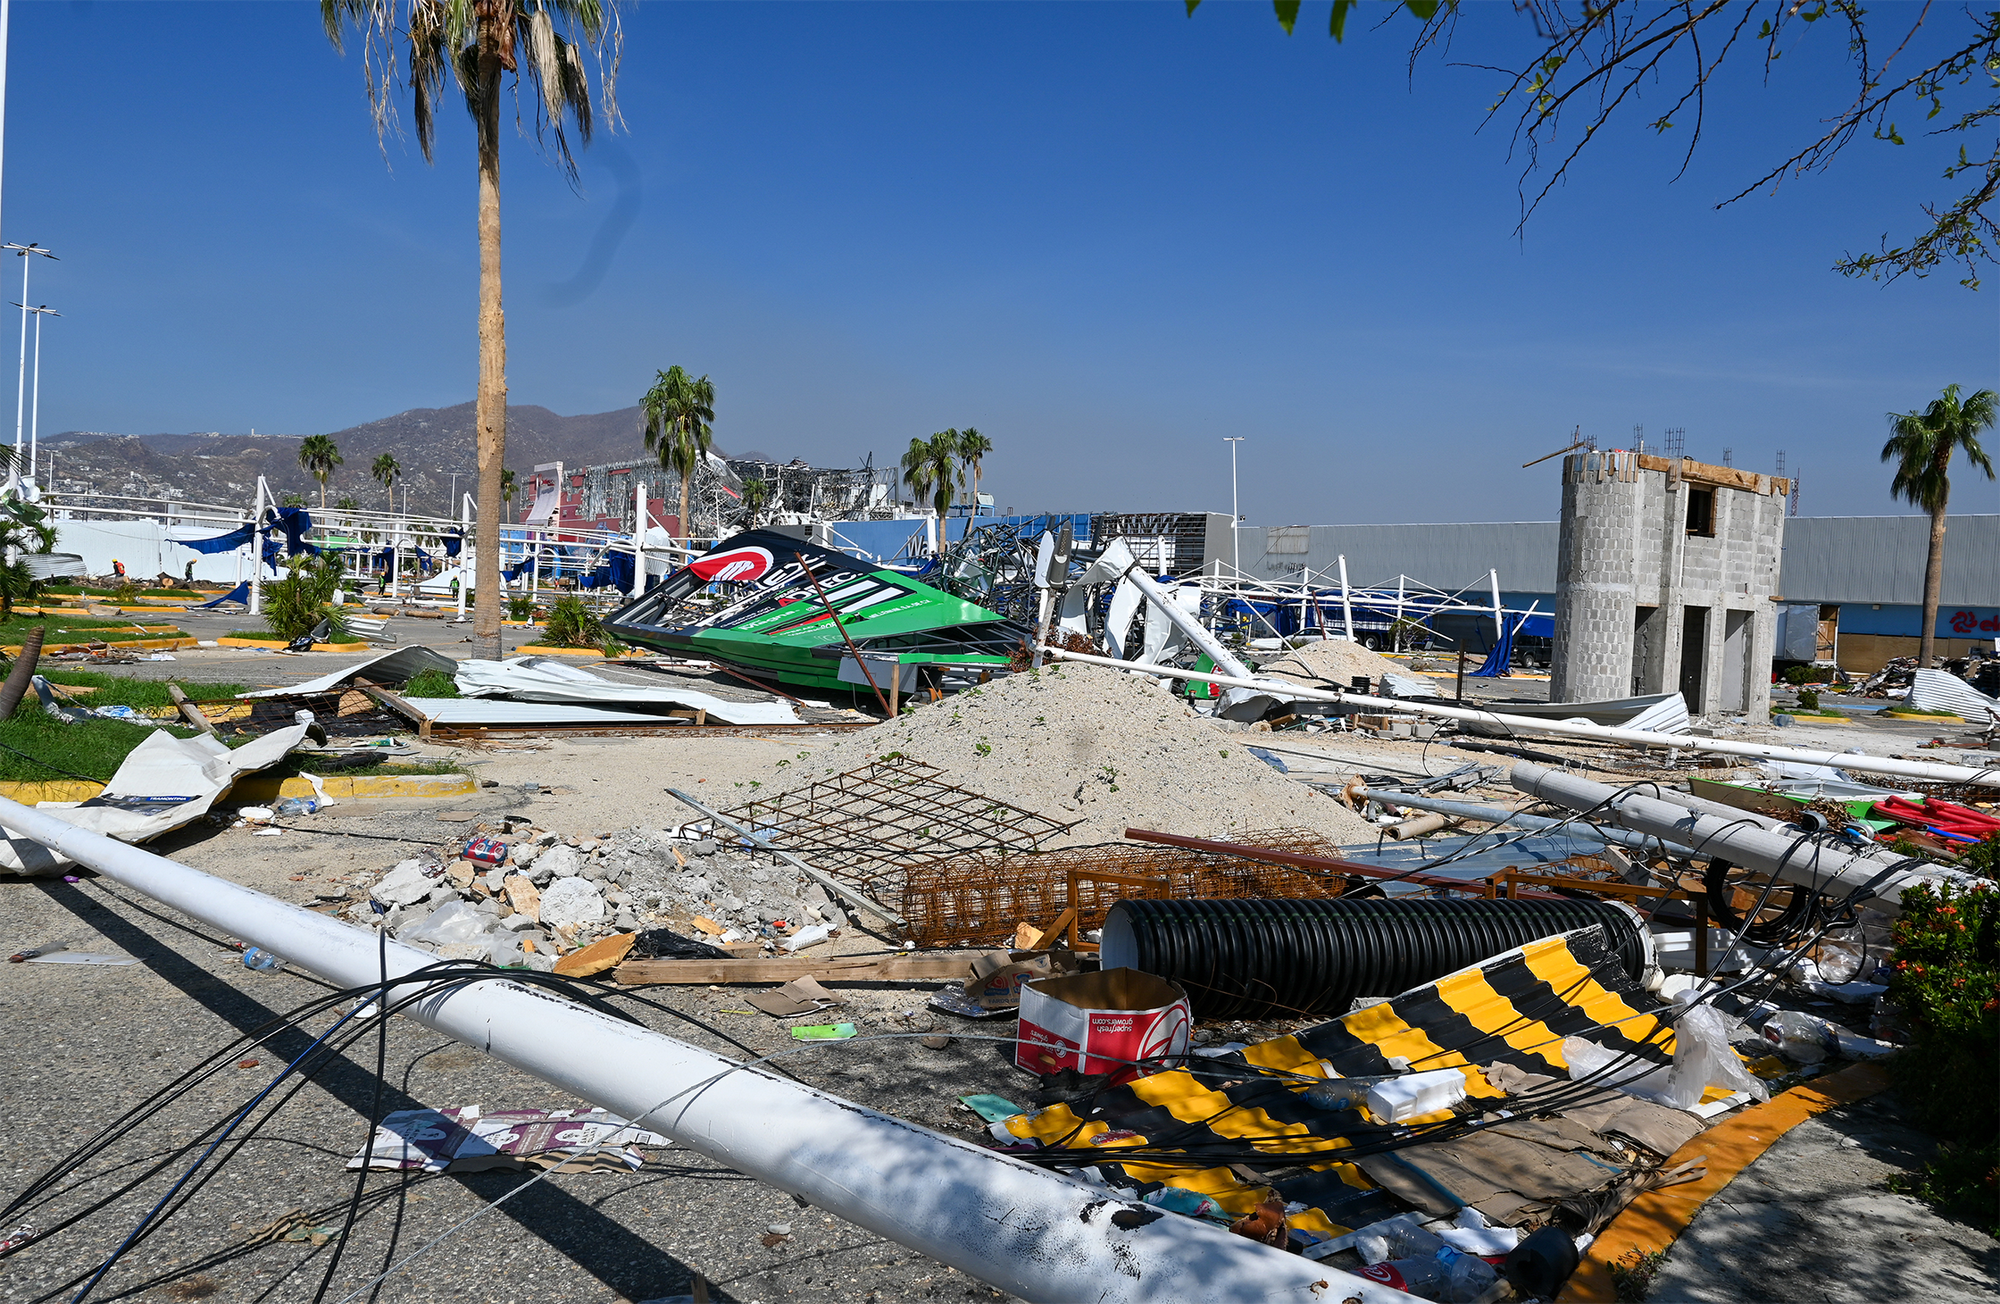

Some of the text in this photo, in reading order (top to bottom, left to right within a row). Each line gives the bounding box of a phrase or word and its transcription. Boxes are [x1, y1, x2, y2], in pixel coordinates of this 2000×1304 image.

[1980, 615, 2000, 632] el
[1091, 1017, 1134, 1025] growers.com
[1096, 1024, 1132, 1033] superfresh
